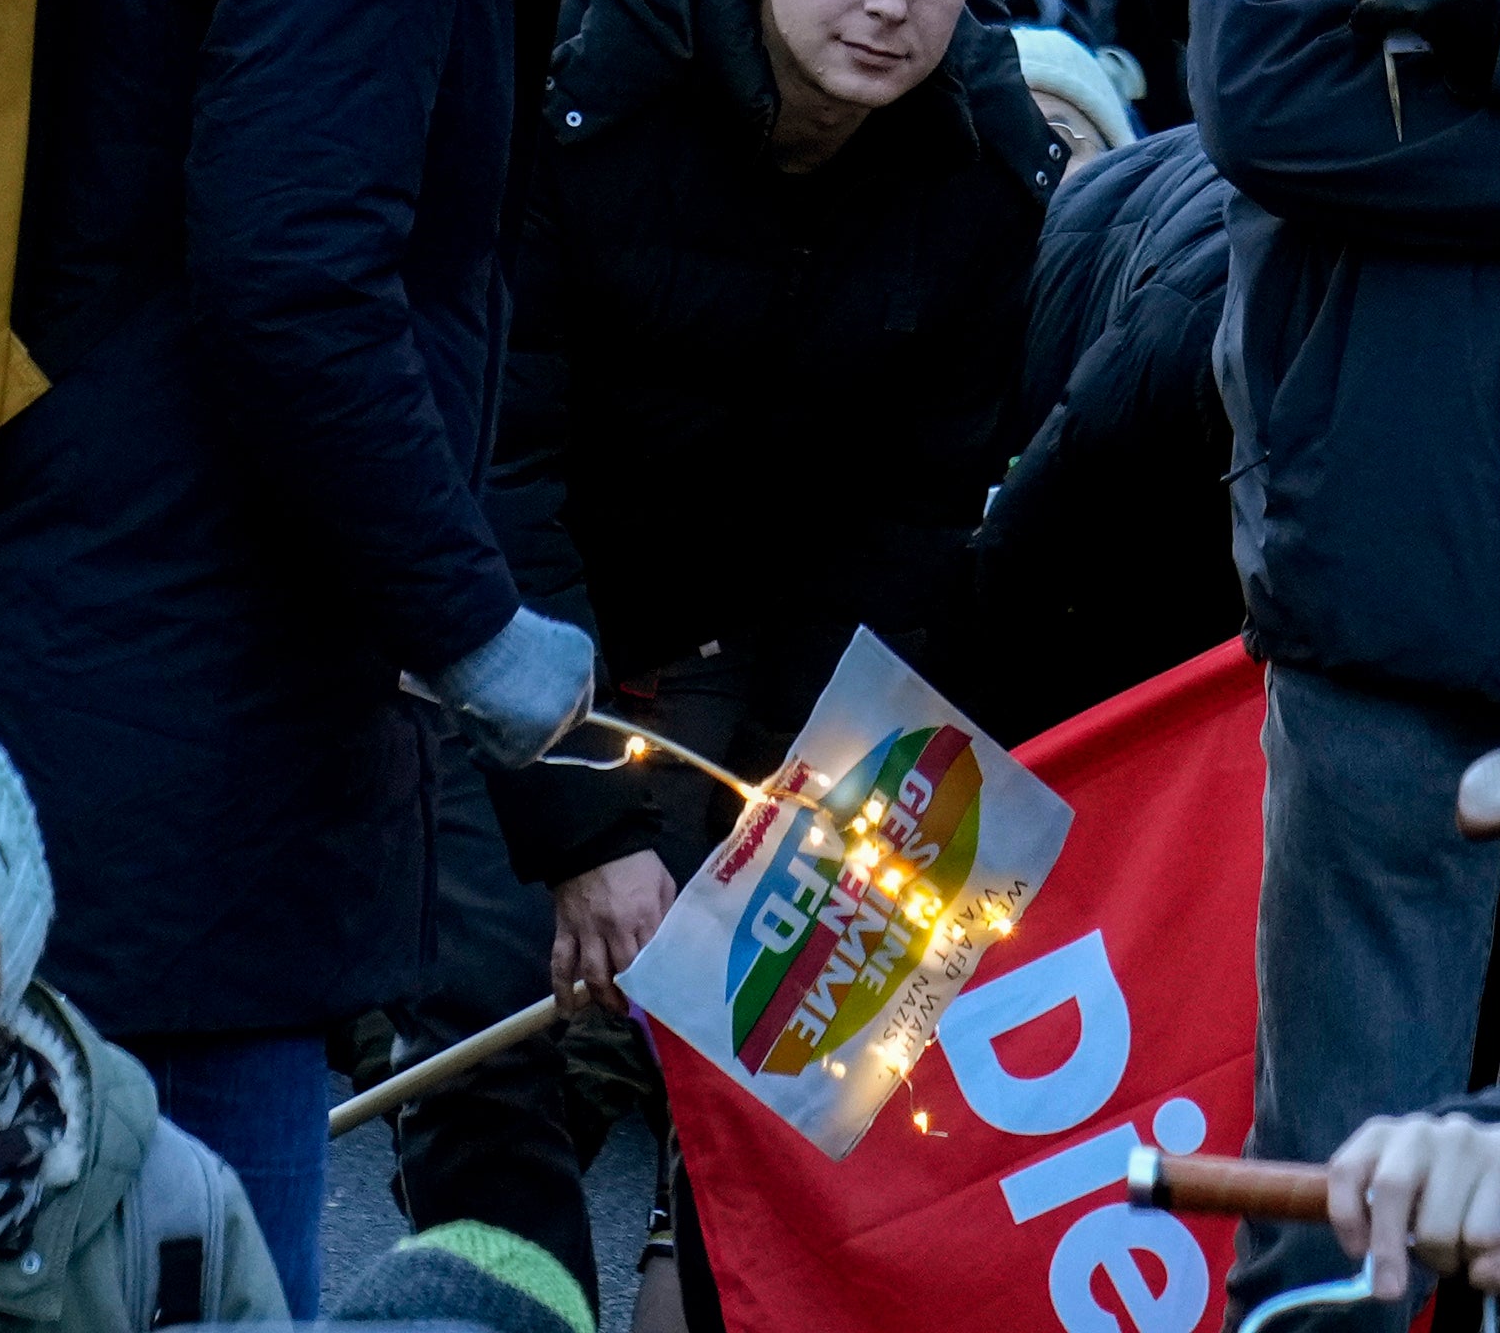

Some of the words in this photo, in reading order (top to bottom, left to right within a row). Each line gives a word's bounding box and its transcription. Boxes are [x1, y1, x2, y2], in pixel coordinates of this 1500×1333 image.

[752, 806, 846, 954] AFD
[789, 831, 941, 1047] SIMME
[945, 935, 973, 981] AFD
[938, 928, 1209, 1333] Die
